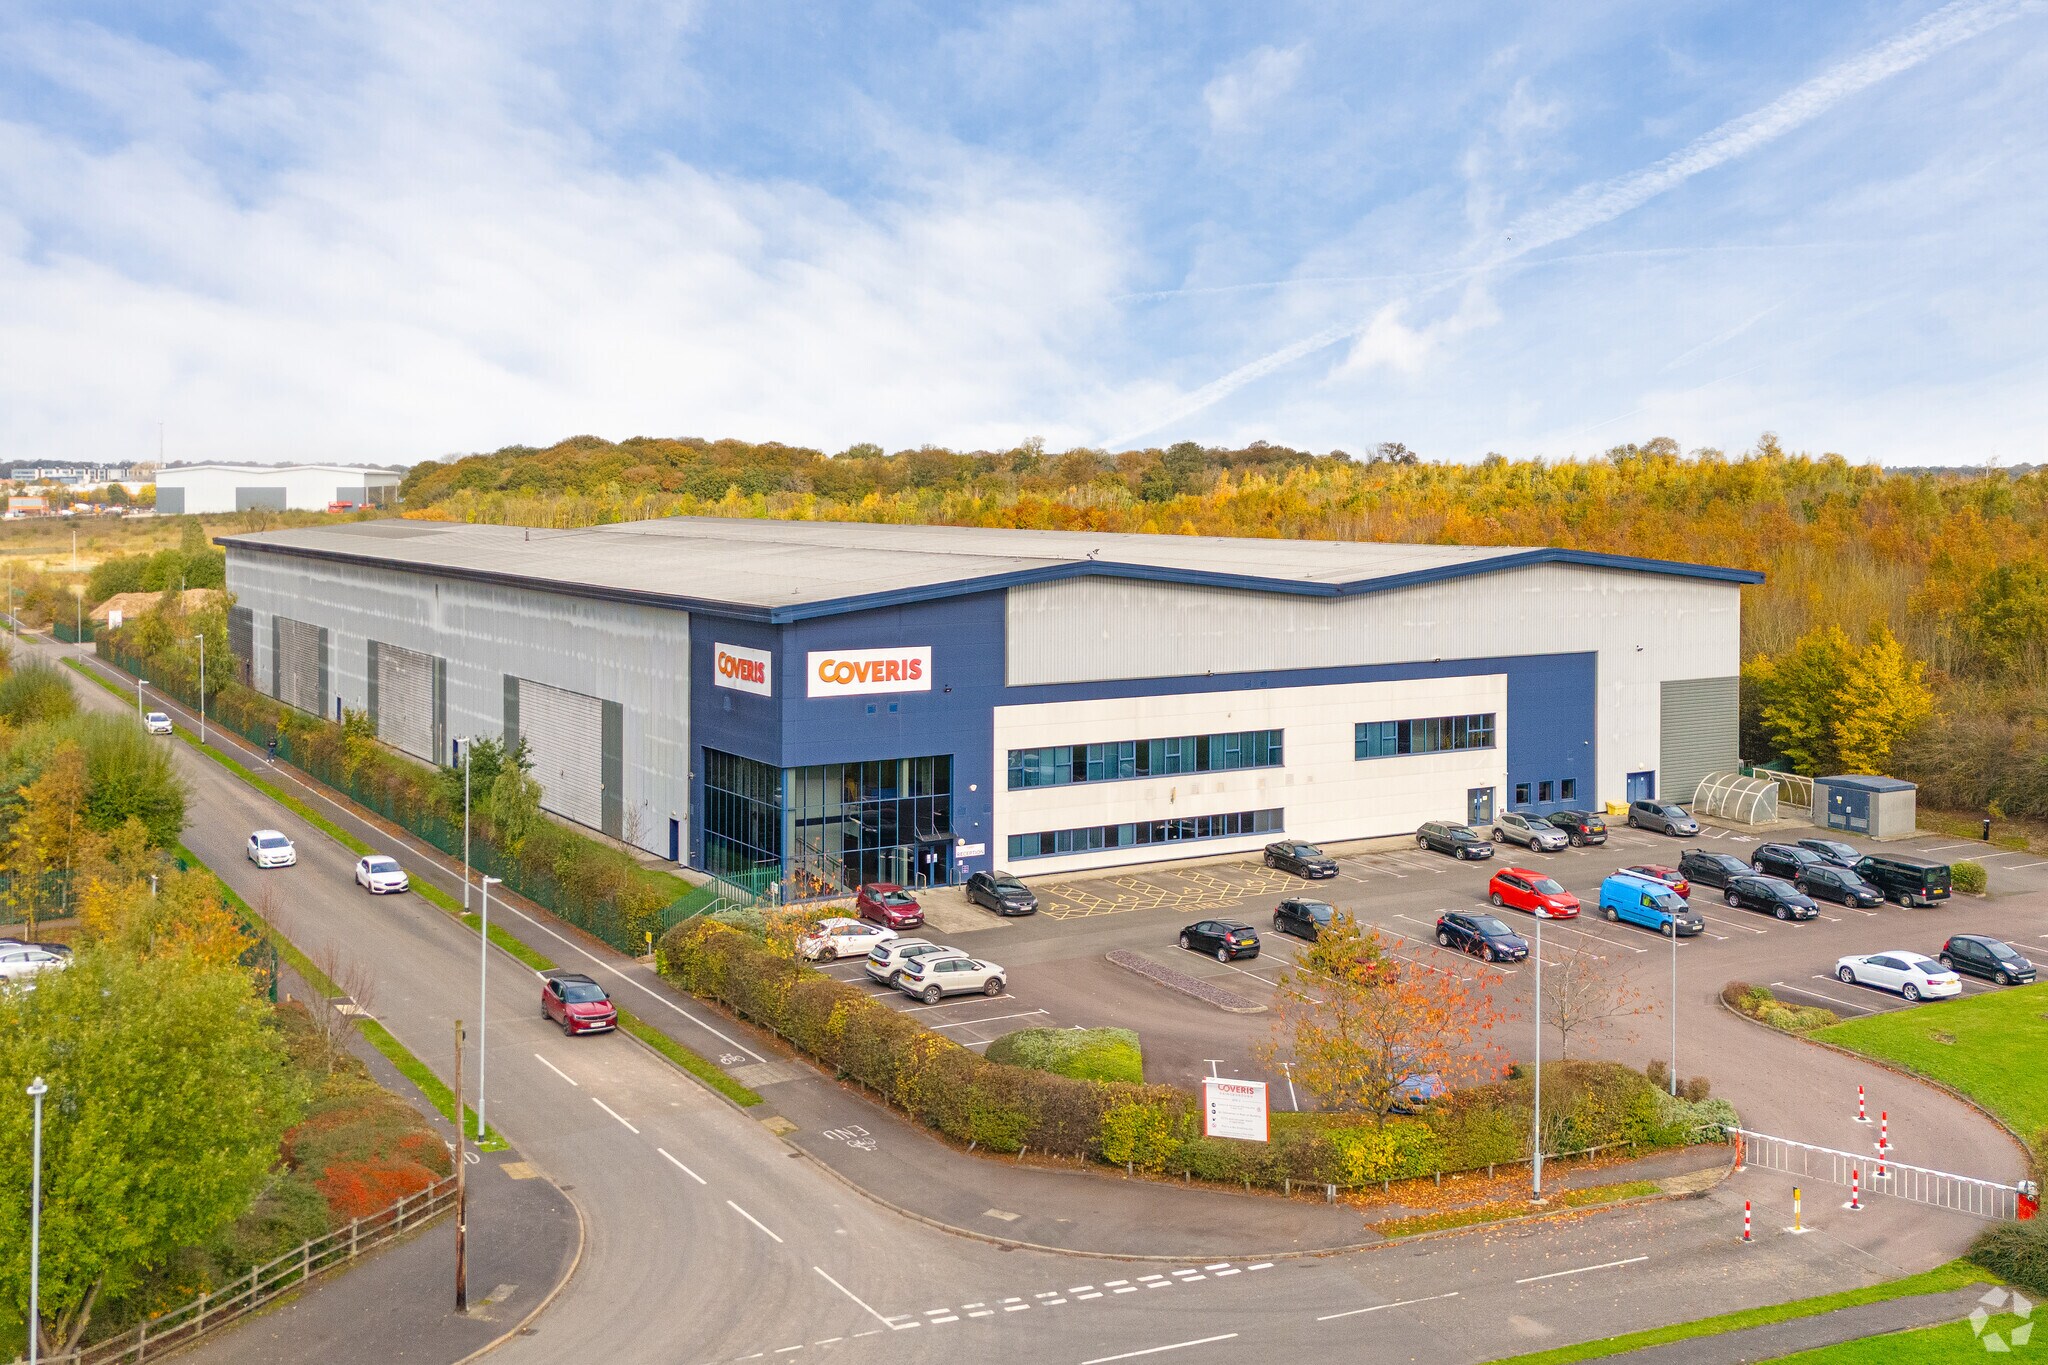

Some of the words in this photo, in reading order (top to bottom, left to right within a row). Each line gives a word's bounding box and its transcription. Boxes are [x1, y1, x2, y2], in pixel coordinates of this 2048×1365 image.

[718, 651, 764, 684] COVERIS
[818, 658, 922, 684] COVERIS
[1218, 1084, 1254, 1094] COVERIS
[822, 1124, 870, 1140] END
